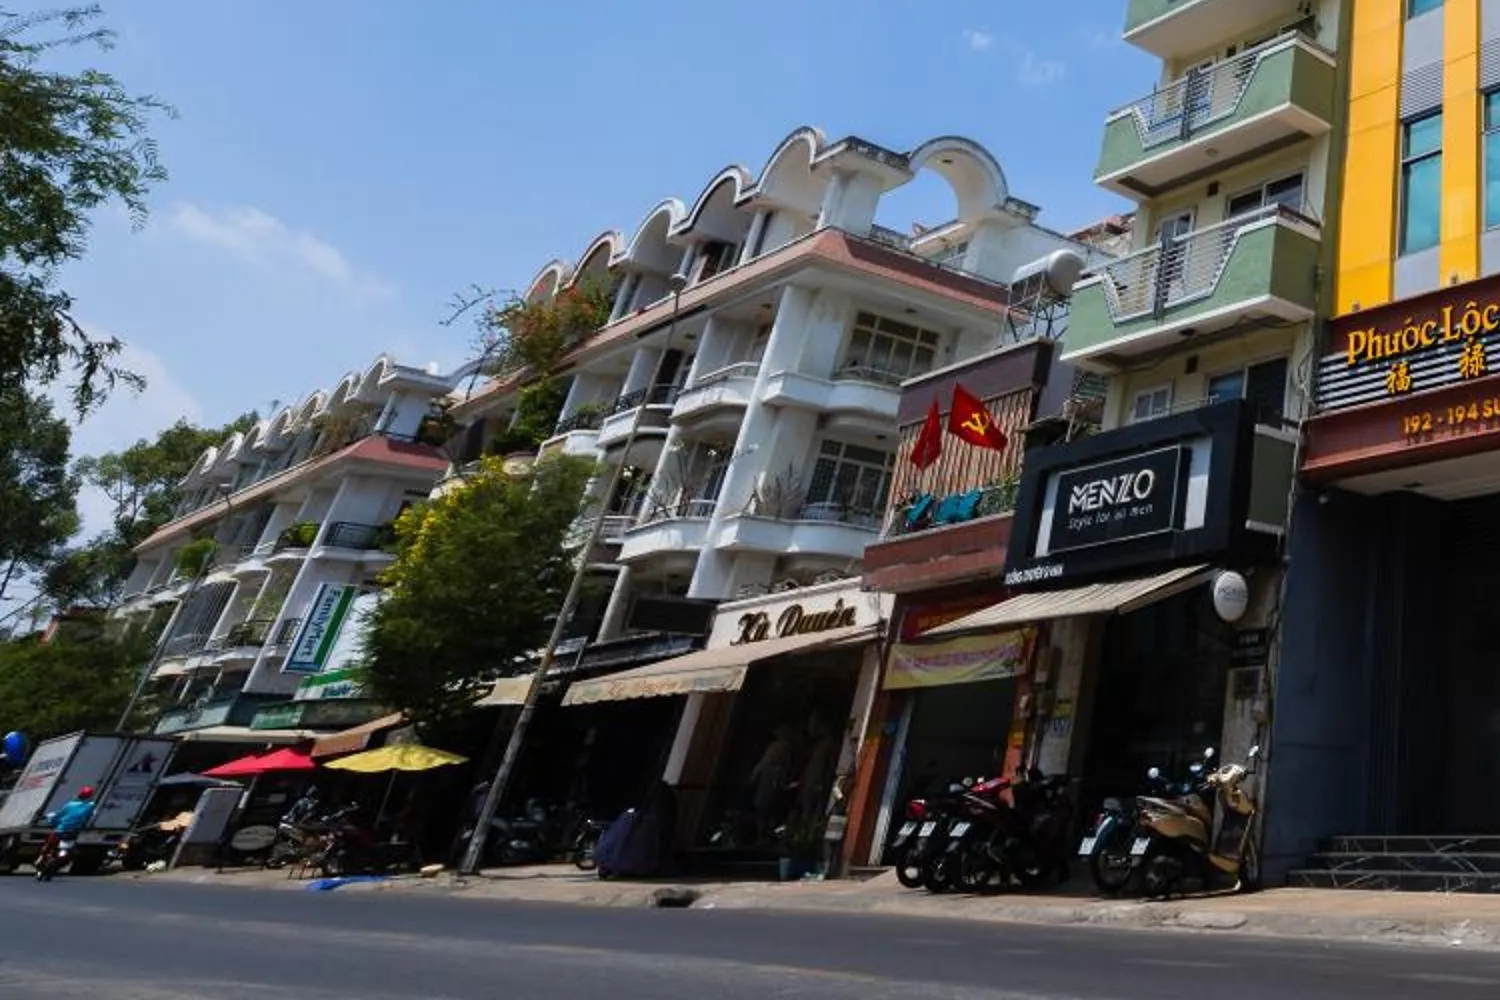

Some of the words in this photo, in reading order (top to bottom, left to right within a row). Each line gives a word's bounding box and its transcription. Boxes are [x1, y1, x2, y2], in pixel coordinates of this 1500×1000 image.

[1347, 316, 1438, 366] Phước
[1442, 300, 1500, 343] Lộc
[1403, 411, 1433, 434] 192
[1447, 402, 1479, 425] 194
[1067, 468, 1156, 515] MENZO
